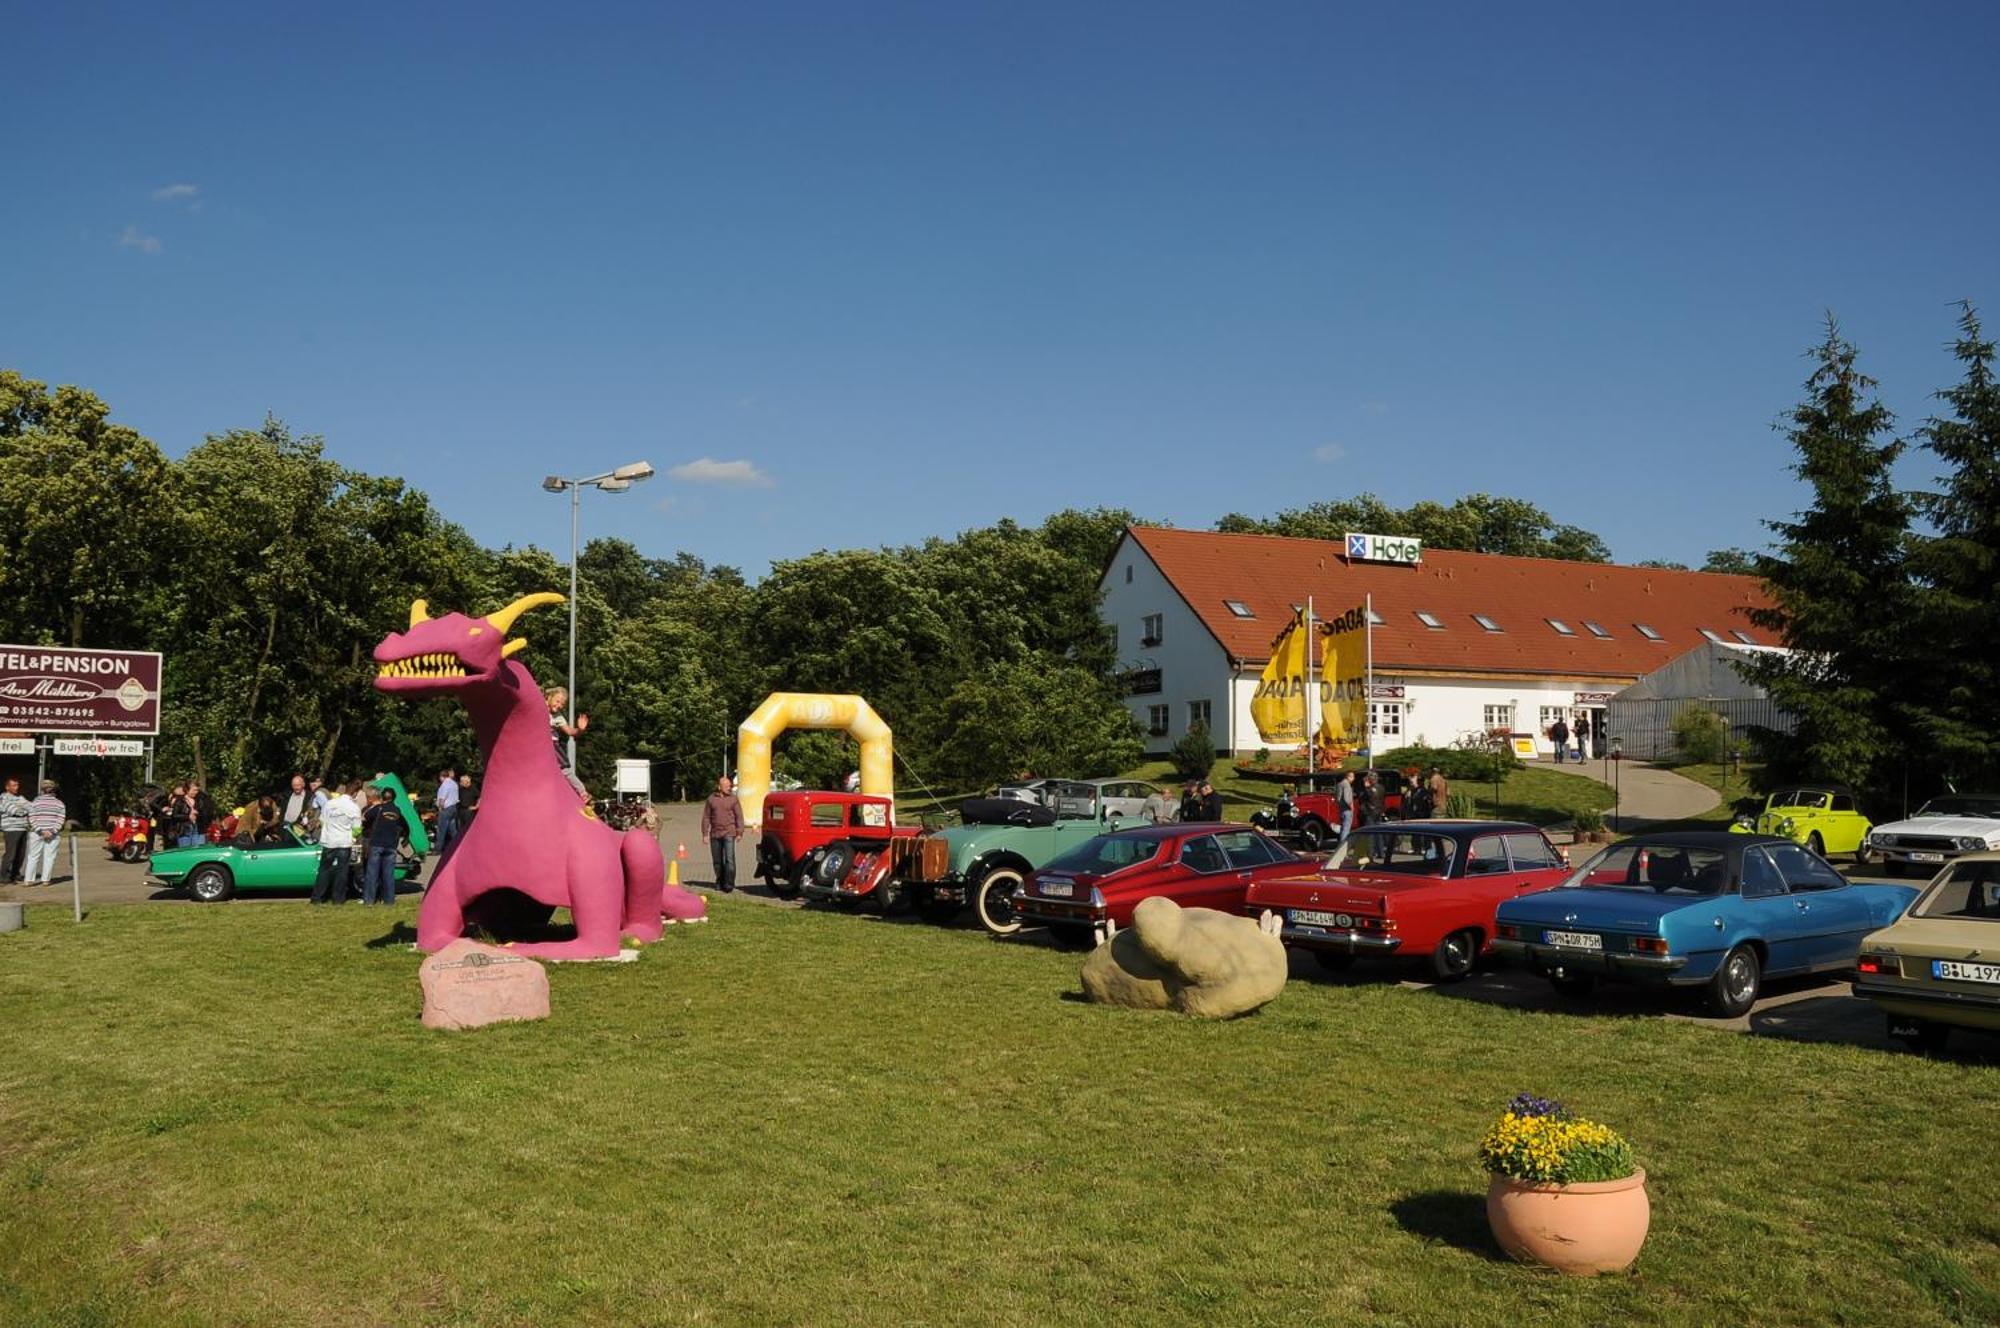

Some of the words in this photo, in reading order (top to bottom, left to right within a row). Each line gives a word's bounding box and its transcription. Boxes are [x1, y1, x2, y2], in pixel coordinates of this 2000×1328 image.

[1372, 536, 1422, 561] Hotel
[0, 681, 28, 696] Am
[12, 706, 95, 717] 03542-875695
[2, 741, 22, 751] frei
[120, 743, 139, 753] frei
[1547, 932, 1566, 944] SPN
[1942, 963, 1951, 977] B
[1961, 965, 1971, 978] L
